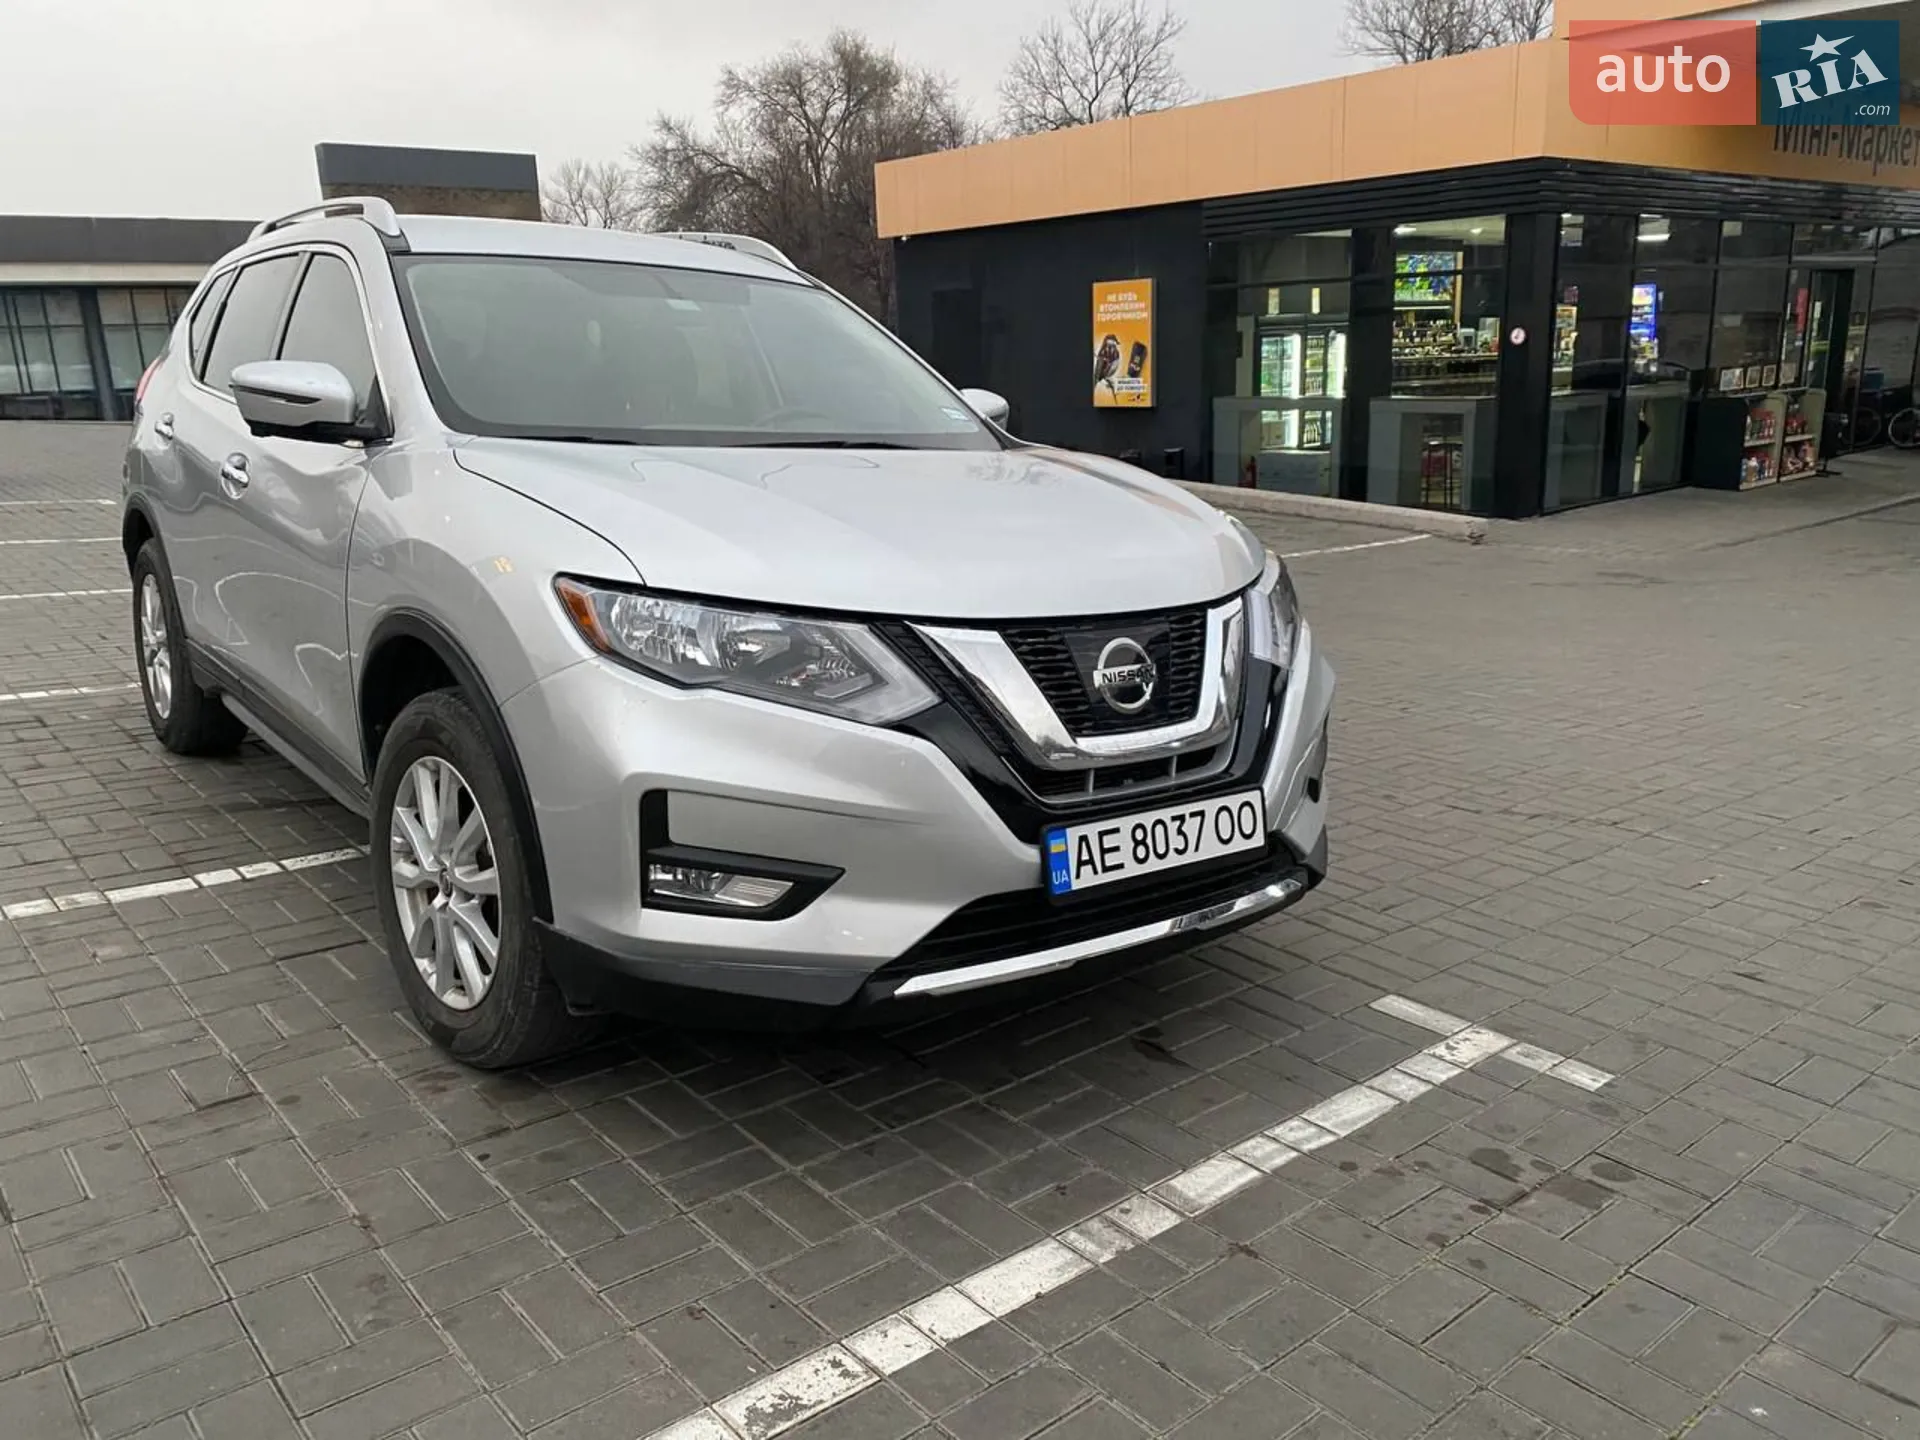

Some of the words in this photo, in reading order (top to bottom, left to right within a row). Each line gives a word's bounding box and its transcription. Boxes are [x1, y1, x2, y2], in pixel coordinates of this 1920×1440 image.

[1102, 664, 1154, 684] NISSAN
[1075, 827, 1125, 880] AE
[1130, 809, 1206, 865] 8037
[1214, 801, 1257, 846] OO
[1052, 869, 1069, 885] UA
